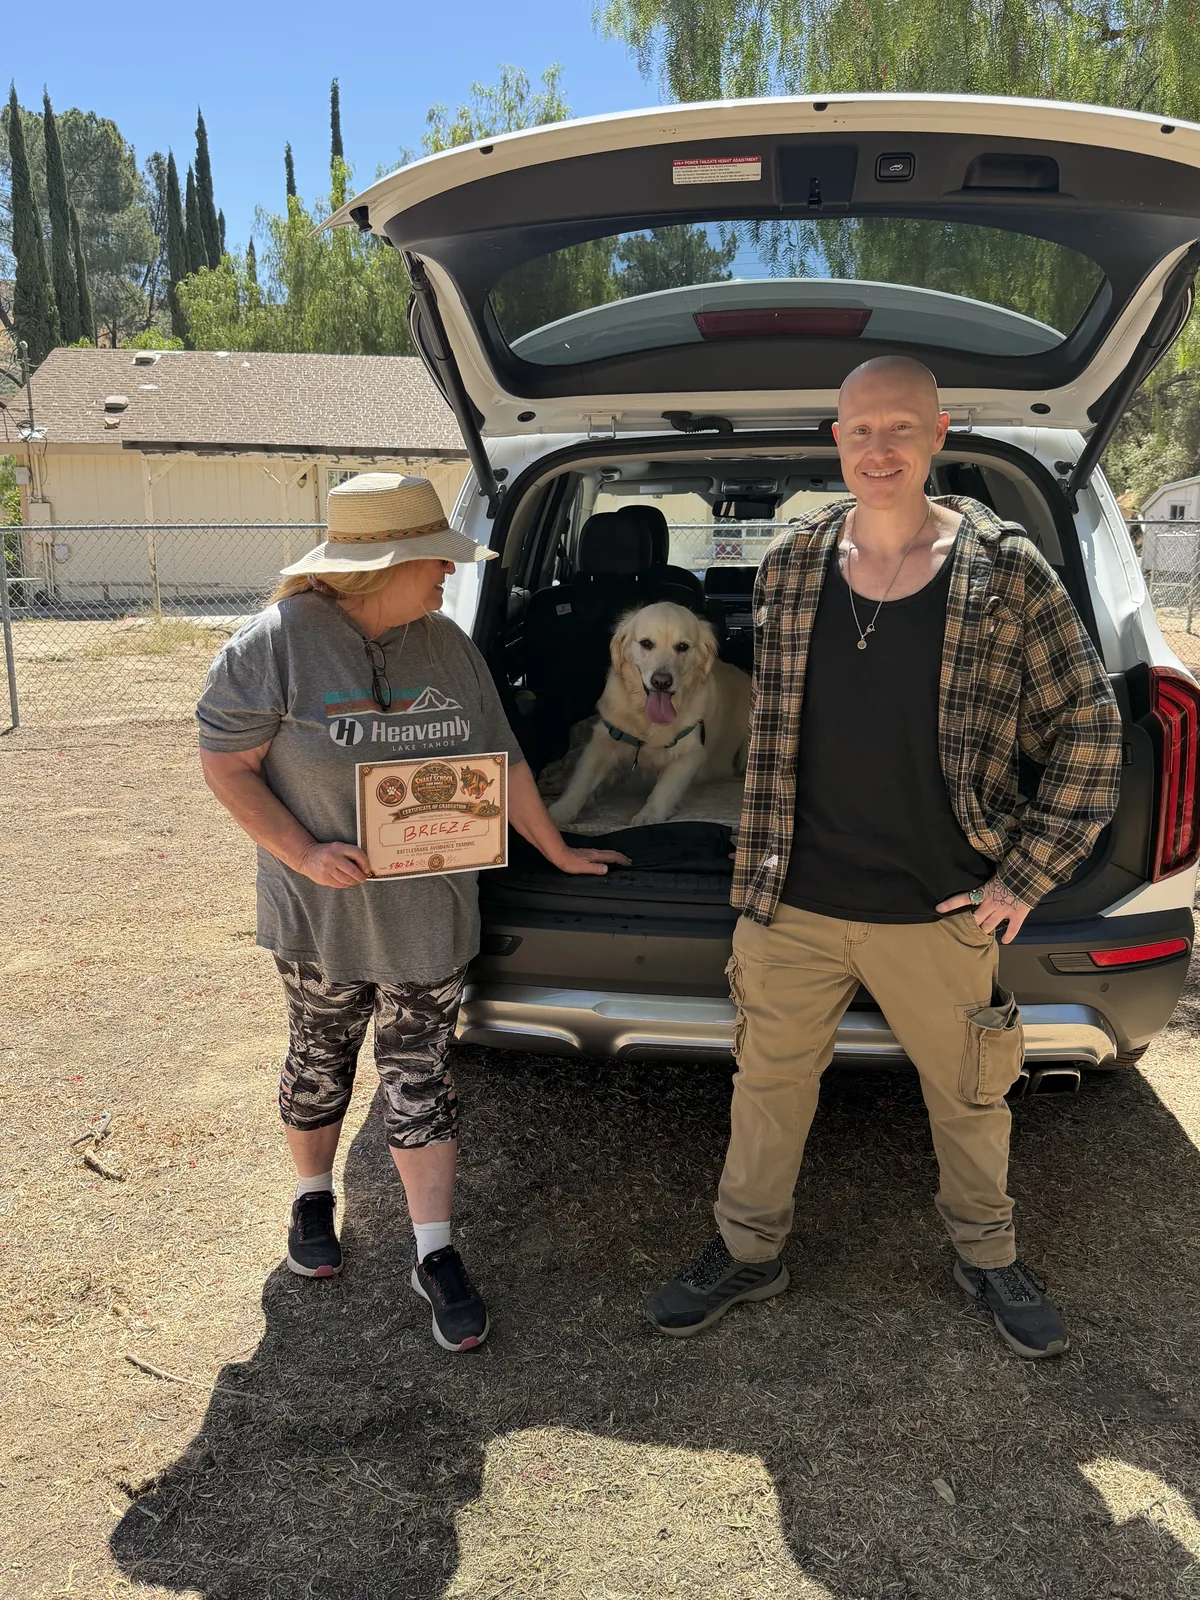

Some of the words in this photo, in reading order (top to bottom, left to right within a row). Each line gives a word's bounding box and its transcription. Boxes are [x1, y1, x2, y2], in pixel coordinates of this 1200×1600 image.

[371, 715, 471, 743] Heavenly
[392, 744, 416, 752] LAKE
[422, 740, 455, 749] TAHOE
[402, 804, 431, 815] CERTIFICATE
[403, 820, 477, 842] BREEZE
[396, 846, 428, 855] RATTLESNAKE
[455, 840, 475, 848] TRAINING
